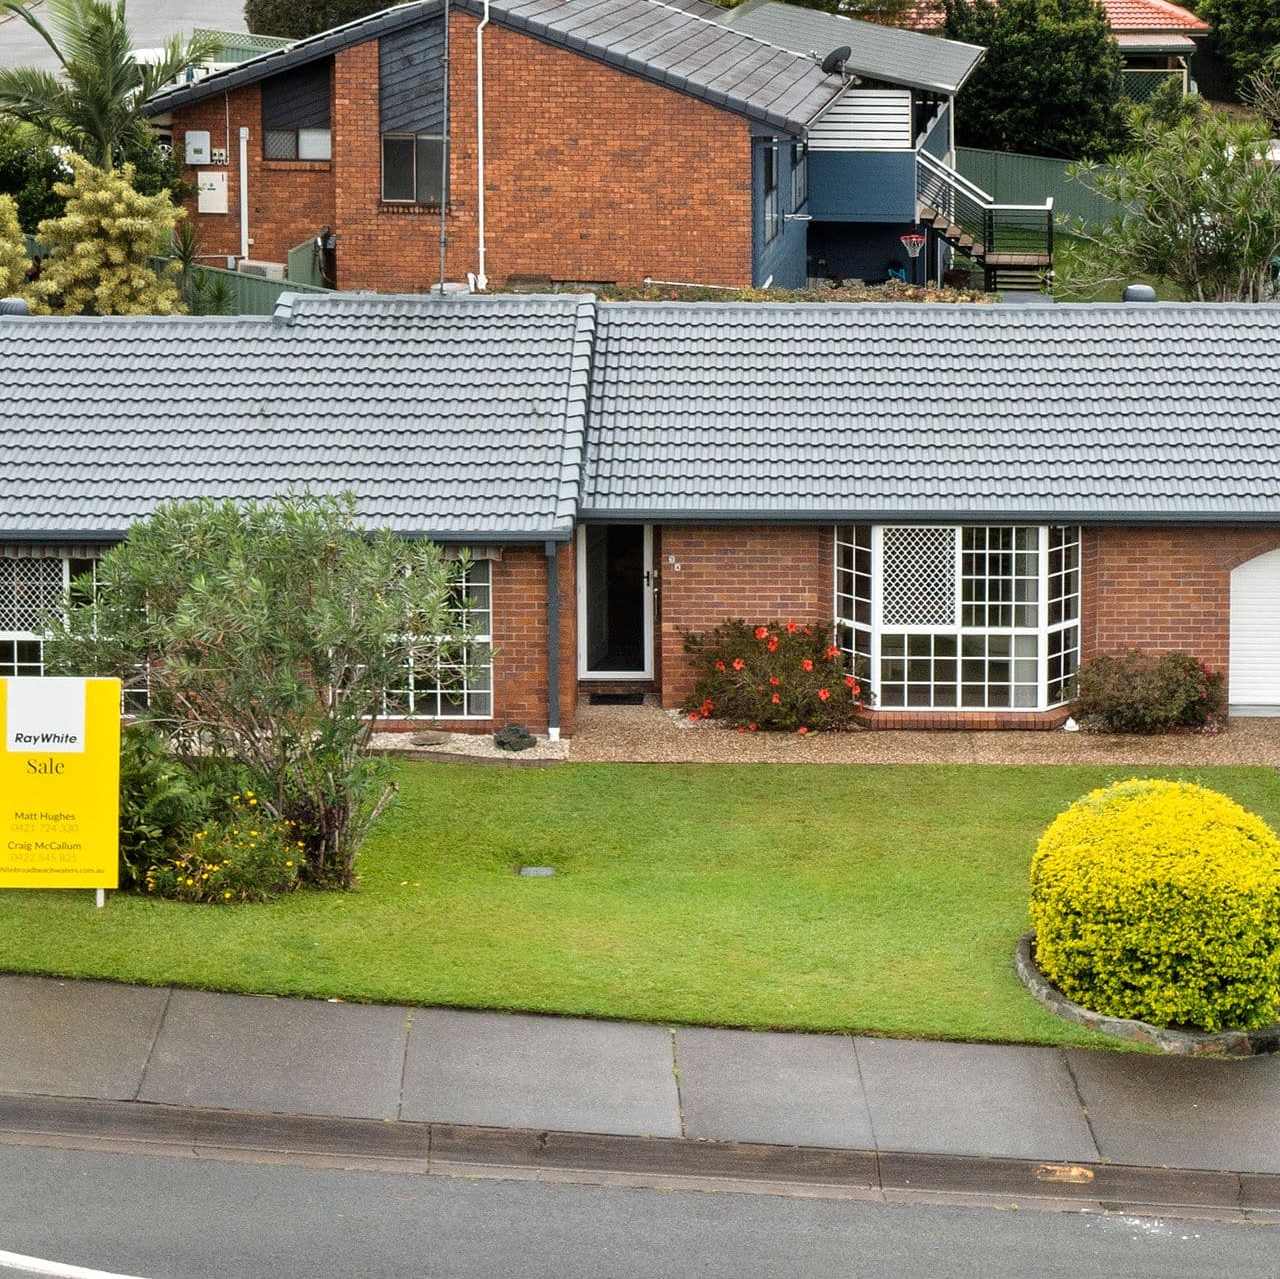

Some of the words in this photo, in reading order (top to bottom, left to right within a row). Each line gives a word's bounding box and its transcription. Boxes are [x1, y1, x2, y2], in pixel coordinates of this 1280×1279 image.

[27, 757, 65, 775] Sale
[15, 812, 37, 820] Matt
[40, 812, 76, 822] Hughes
[11, 824, 35, 833] 0421
[60, 824, 79, 833] 330
[7, 841, 32, 851] Craig
[35, 841, 82, 850] McCallum
